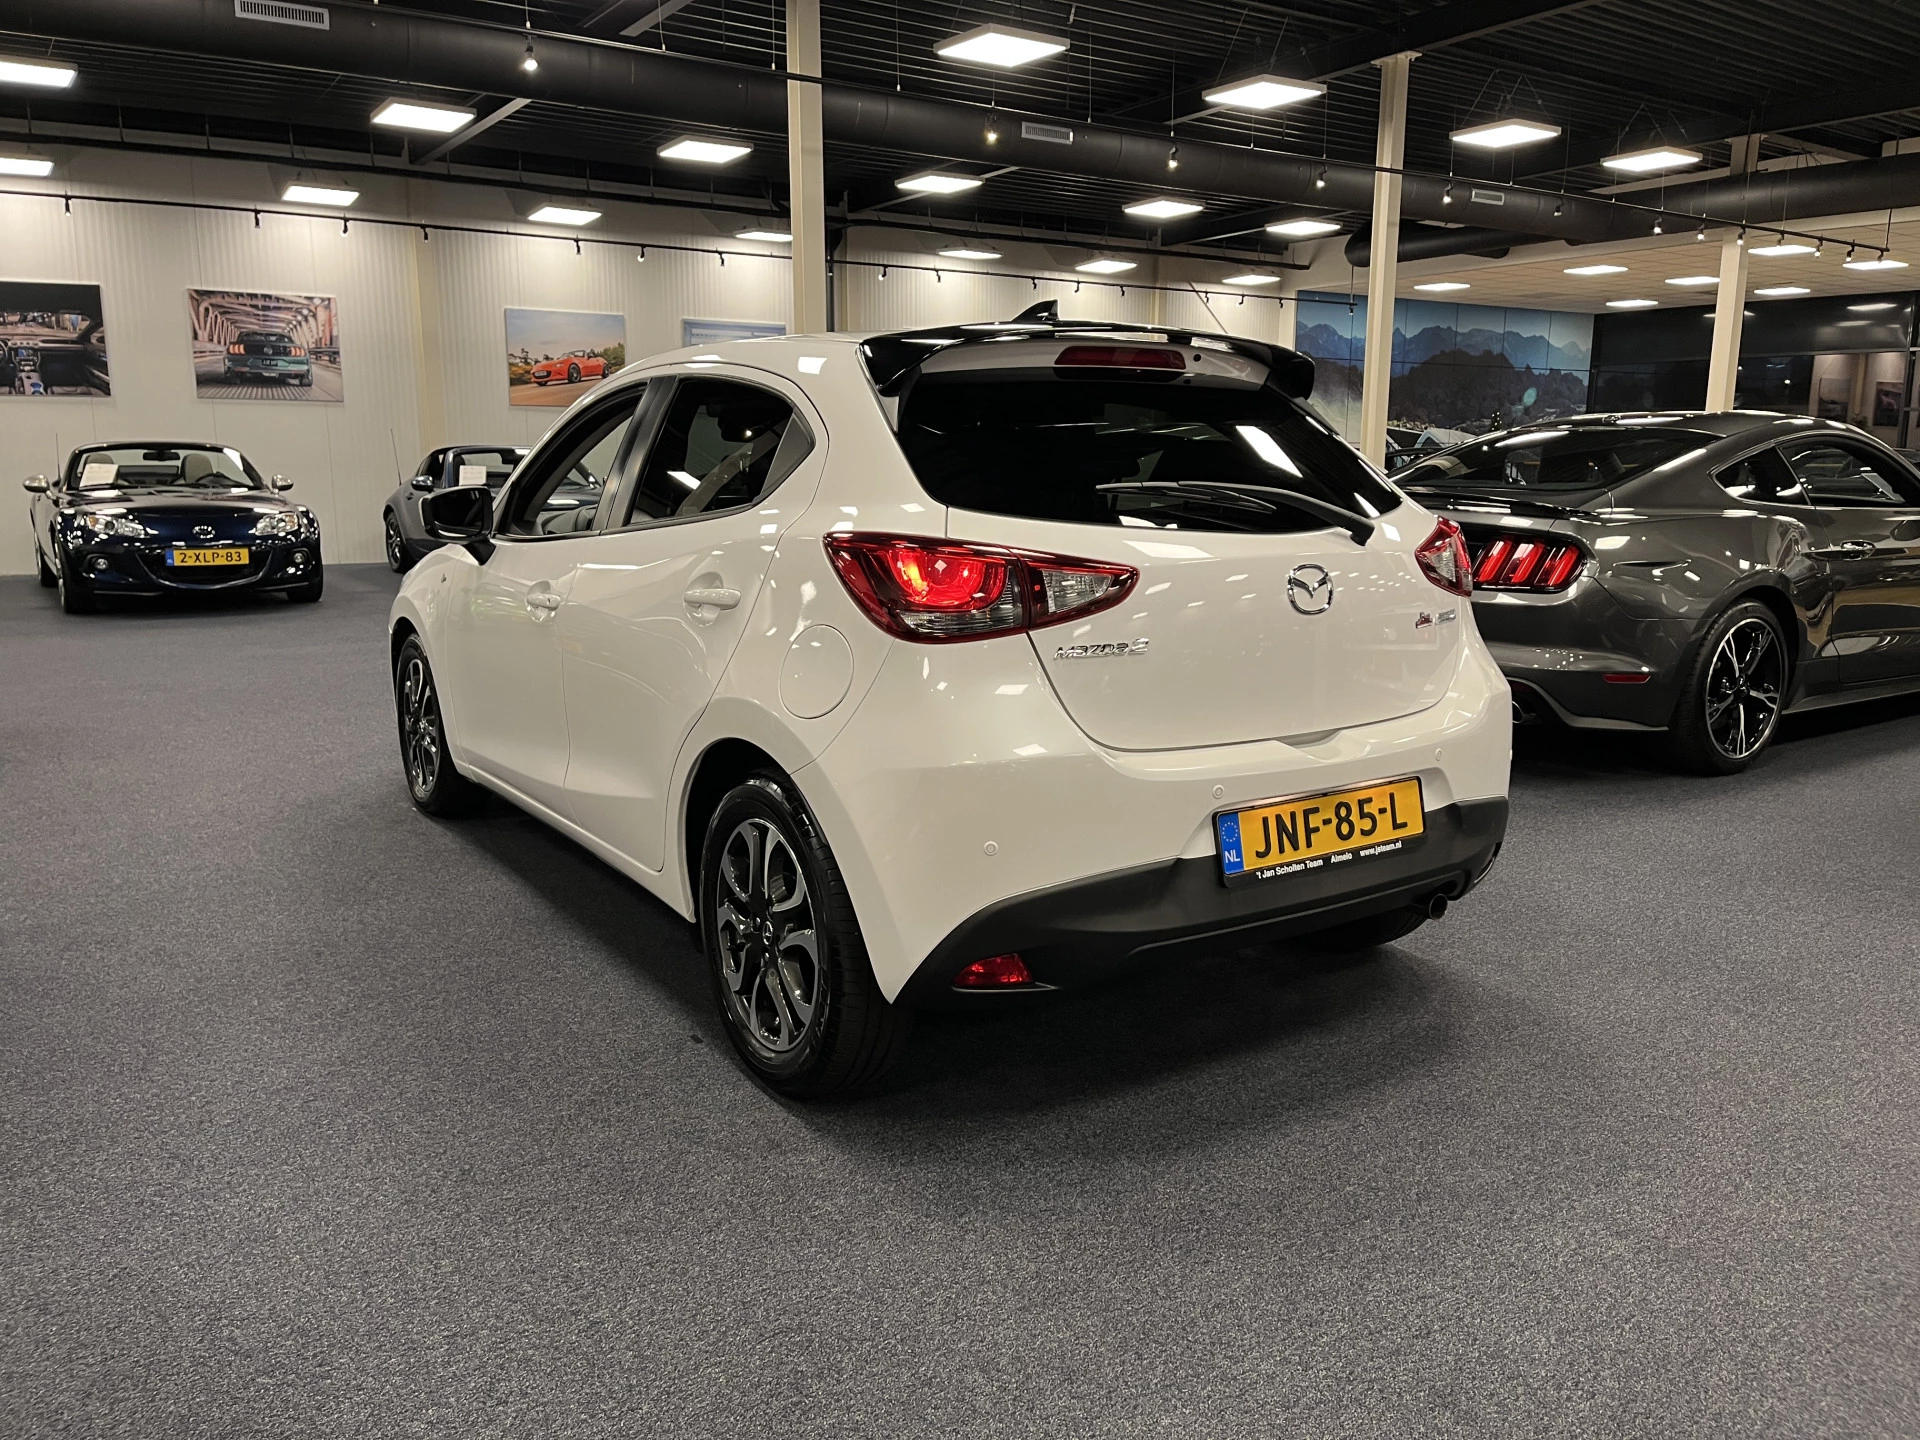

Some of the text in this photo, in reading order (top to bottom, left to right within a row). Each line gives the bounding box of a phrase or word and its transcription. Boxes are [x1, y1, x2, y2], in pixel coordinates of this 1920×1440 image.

[179, 551, 242, 563] 2-XLP-83
[1255, 792, 1408, 859] JNF-85-L
[1224, 850, 1240, 864] NL
[1262, 869, 1275, 879] Jan
[1276, 863, 1305, 875] Scholten
[1306, 859, 1323, 869] Team
[1331, 852, 1353, 864] Almelo
[1359, 841, 1402, 857] www.jsteam.nl
